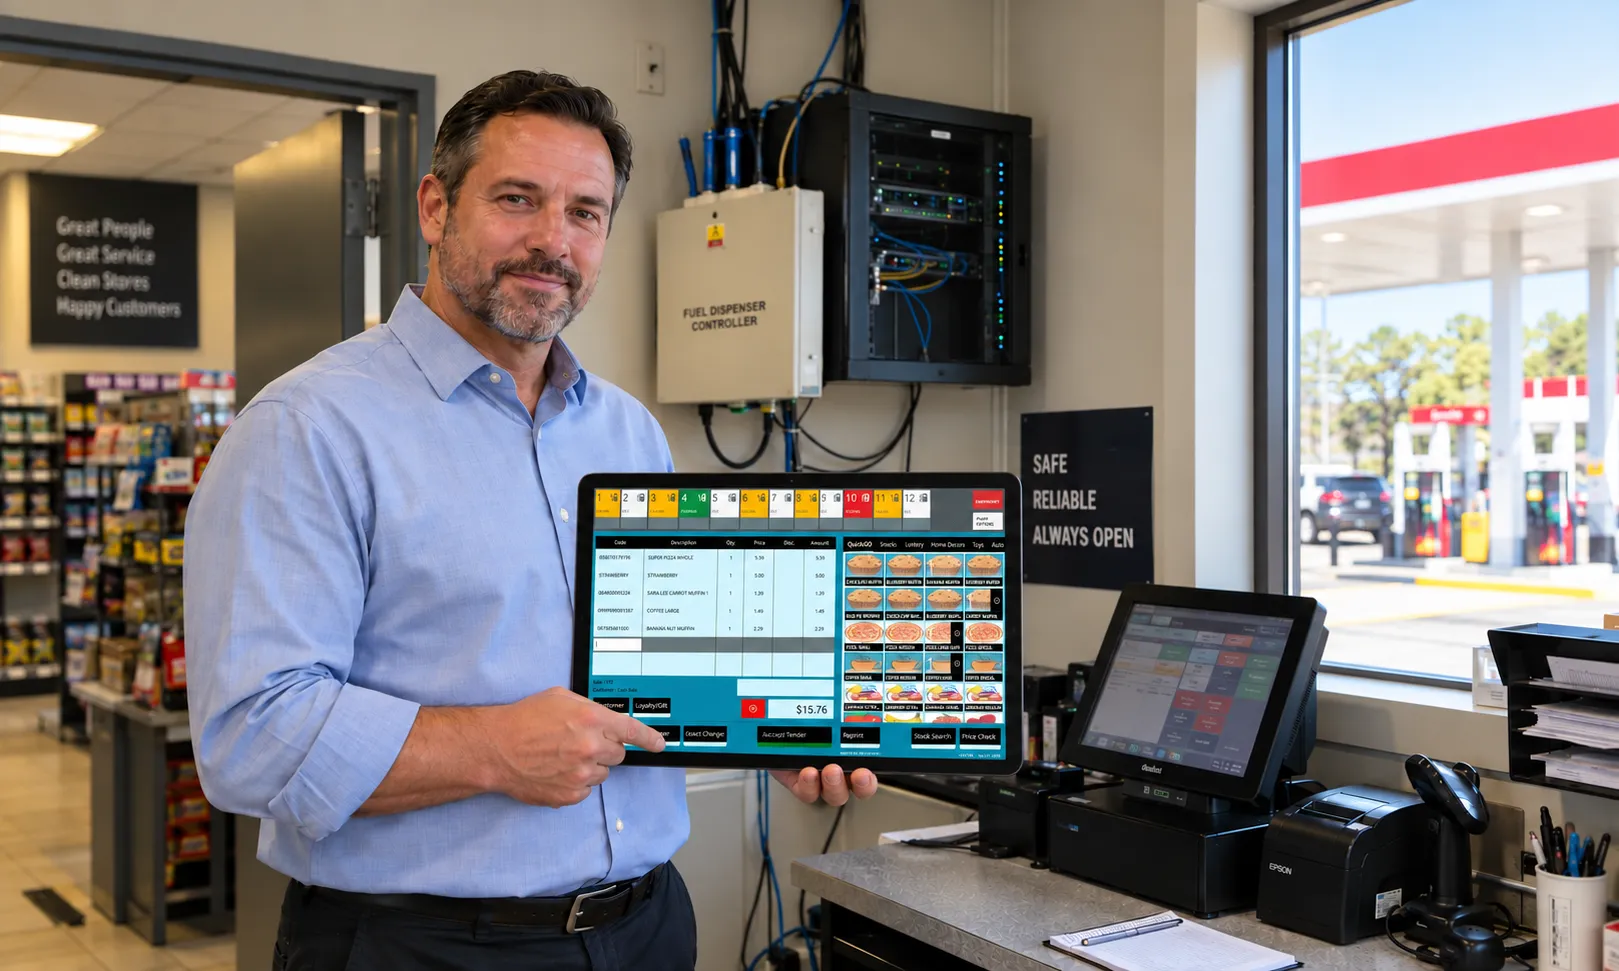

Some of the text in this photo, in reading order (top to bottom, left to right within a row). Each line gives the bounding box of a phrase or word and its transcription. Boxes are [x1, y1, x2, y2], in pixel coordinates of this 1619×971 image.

[56, 216, 154, 241] Great People
[56, 243, 155, 265] Great Service
[57, 269, 149, 292] Clean Stores
[57, 296, 181, 319] Happy Customers
[683, 301, 766, 319] FUEL DISPENSER
[692, 316, 757, 331] CONTROLLER
[1033, 454, 1068, 473] SAFE
[598, 493, 601, 502] 1
[623, 493, 628, 502] 2
[651, 493, 656, 502] 3
[681, 493, 687, 502] 4
[712, 493, 718, 502] 5
[742, 493, 748, 502] 6
[772, 493, 777, 502] 7
[846, 493, 857, 502] 10
[876, 493, 885, 502] 11
[905, 493, 915, 502] 12
[1033, 490, 1097, 510] RELIABLE
[1033, 525, 1134, 548] ALWAYS OPEN
[796, 704, 828, 715] $15.76
[1269, 862, 1292, 875] EPSON
